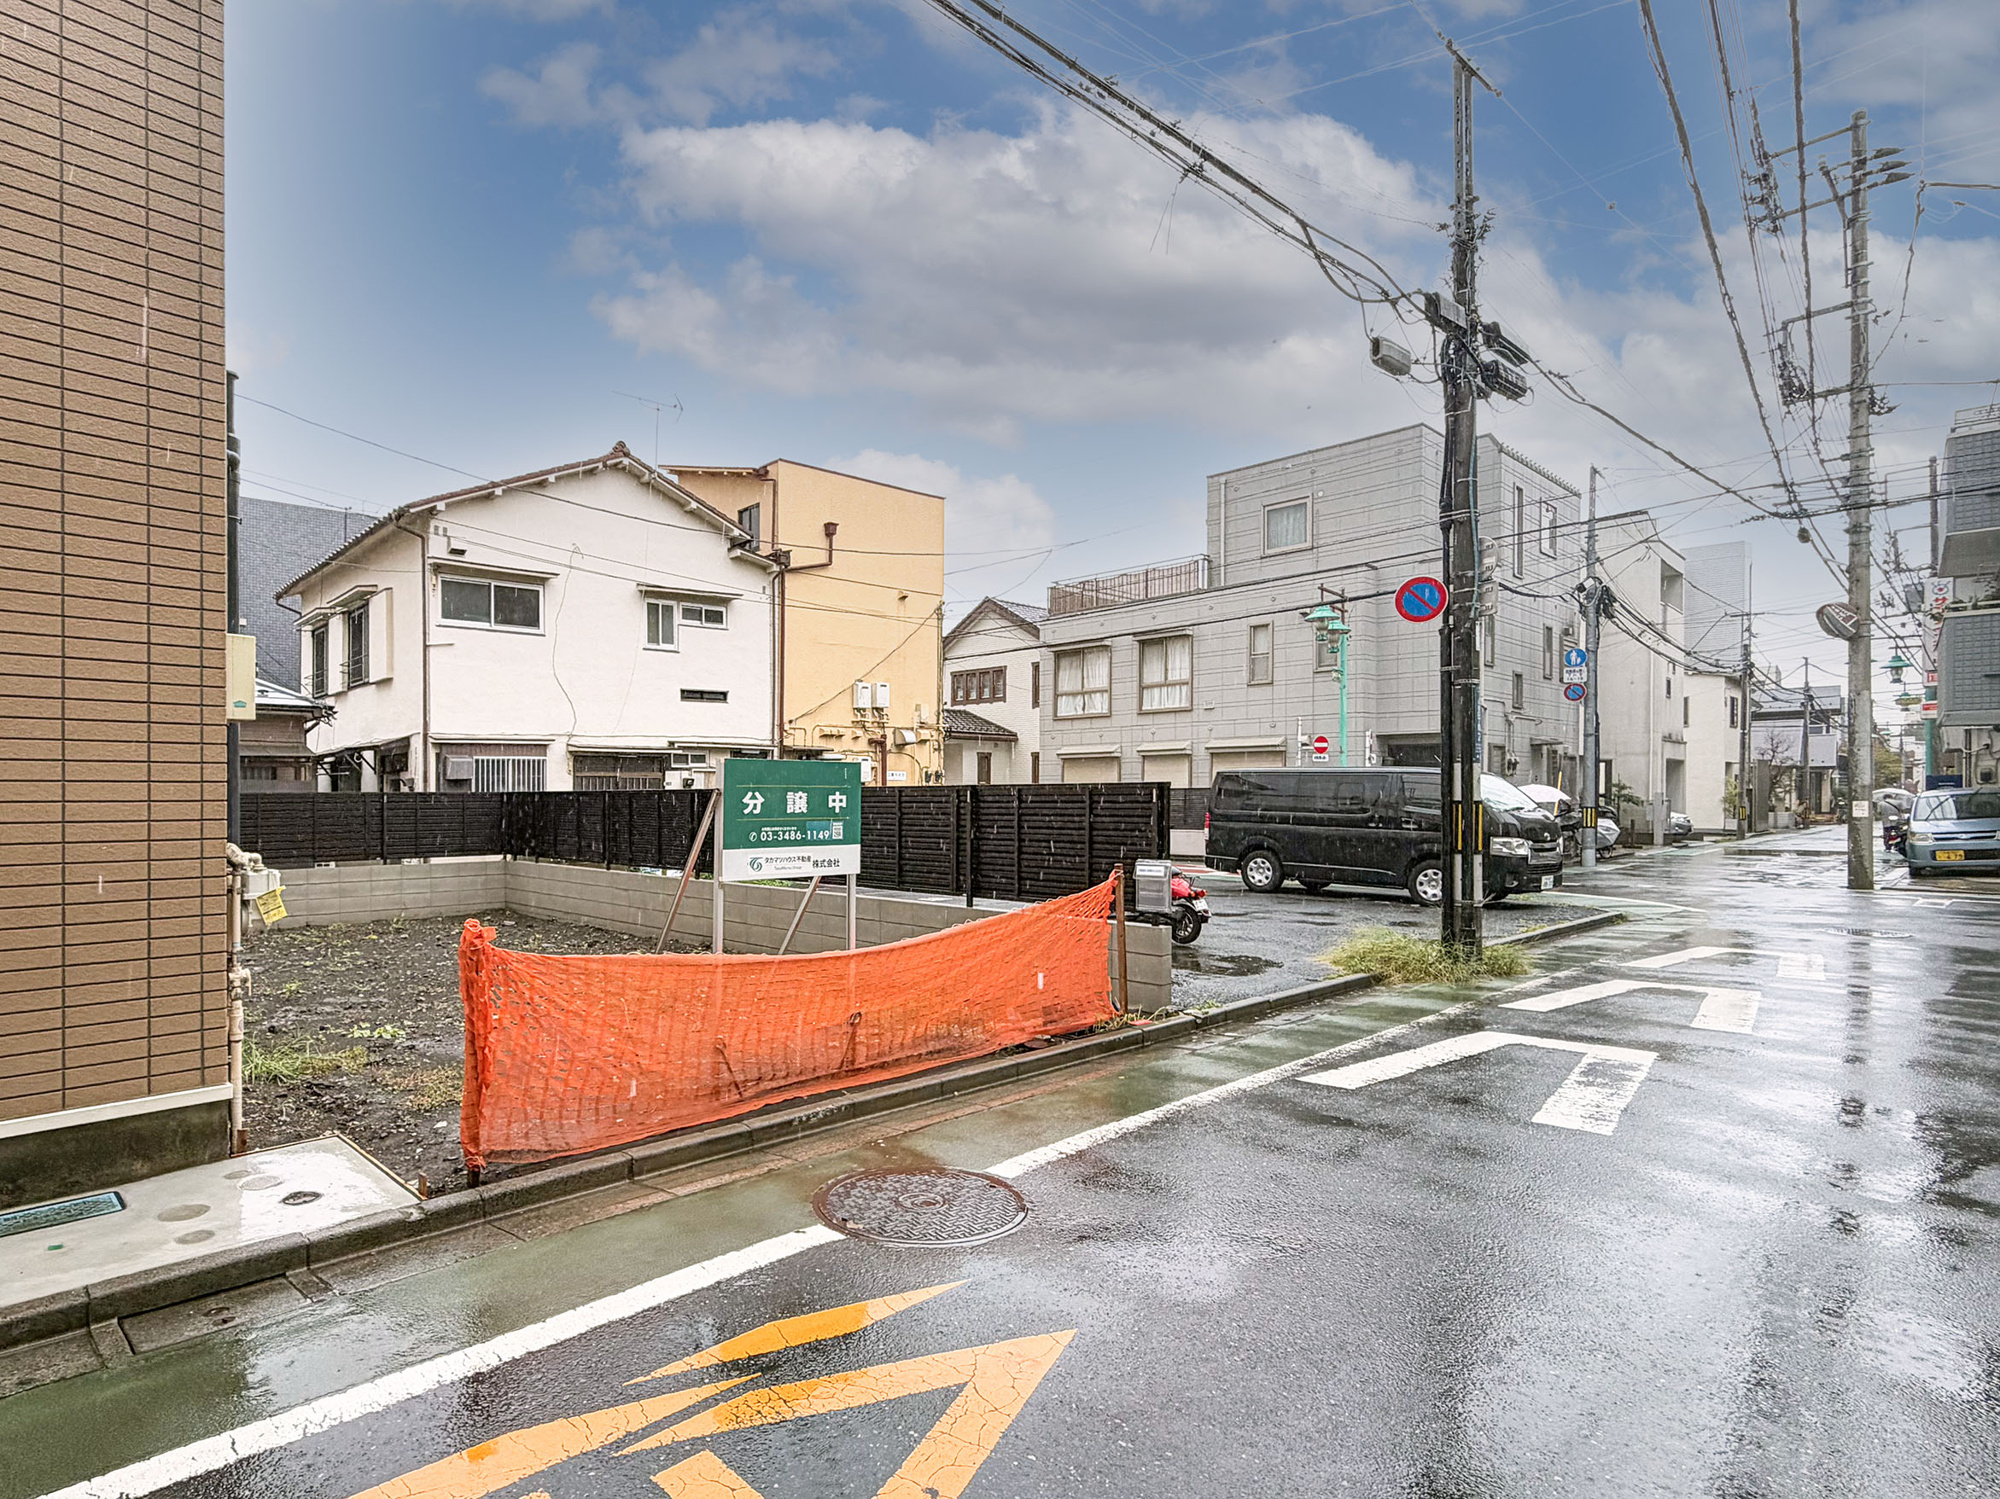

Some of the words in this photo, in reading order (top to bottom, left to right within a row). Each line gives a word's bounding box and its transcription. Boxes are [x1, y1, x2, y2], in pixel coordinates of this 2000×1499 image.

[742, 791, 847, 815] 分譲中
[760, 830, 830, 841] 03-3486-1149
[812, 858, 840, 869] 株式会社
